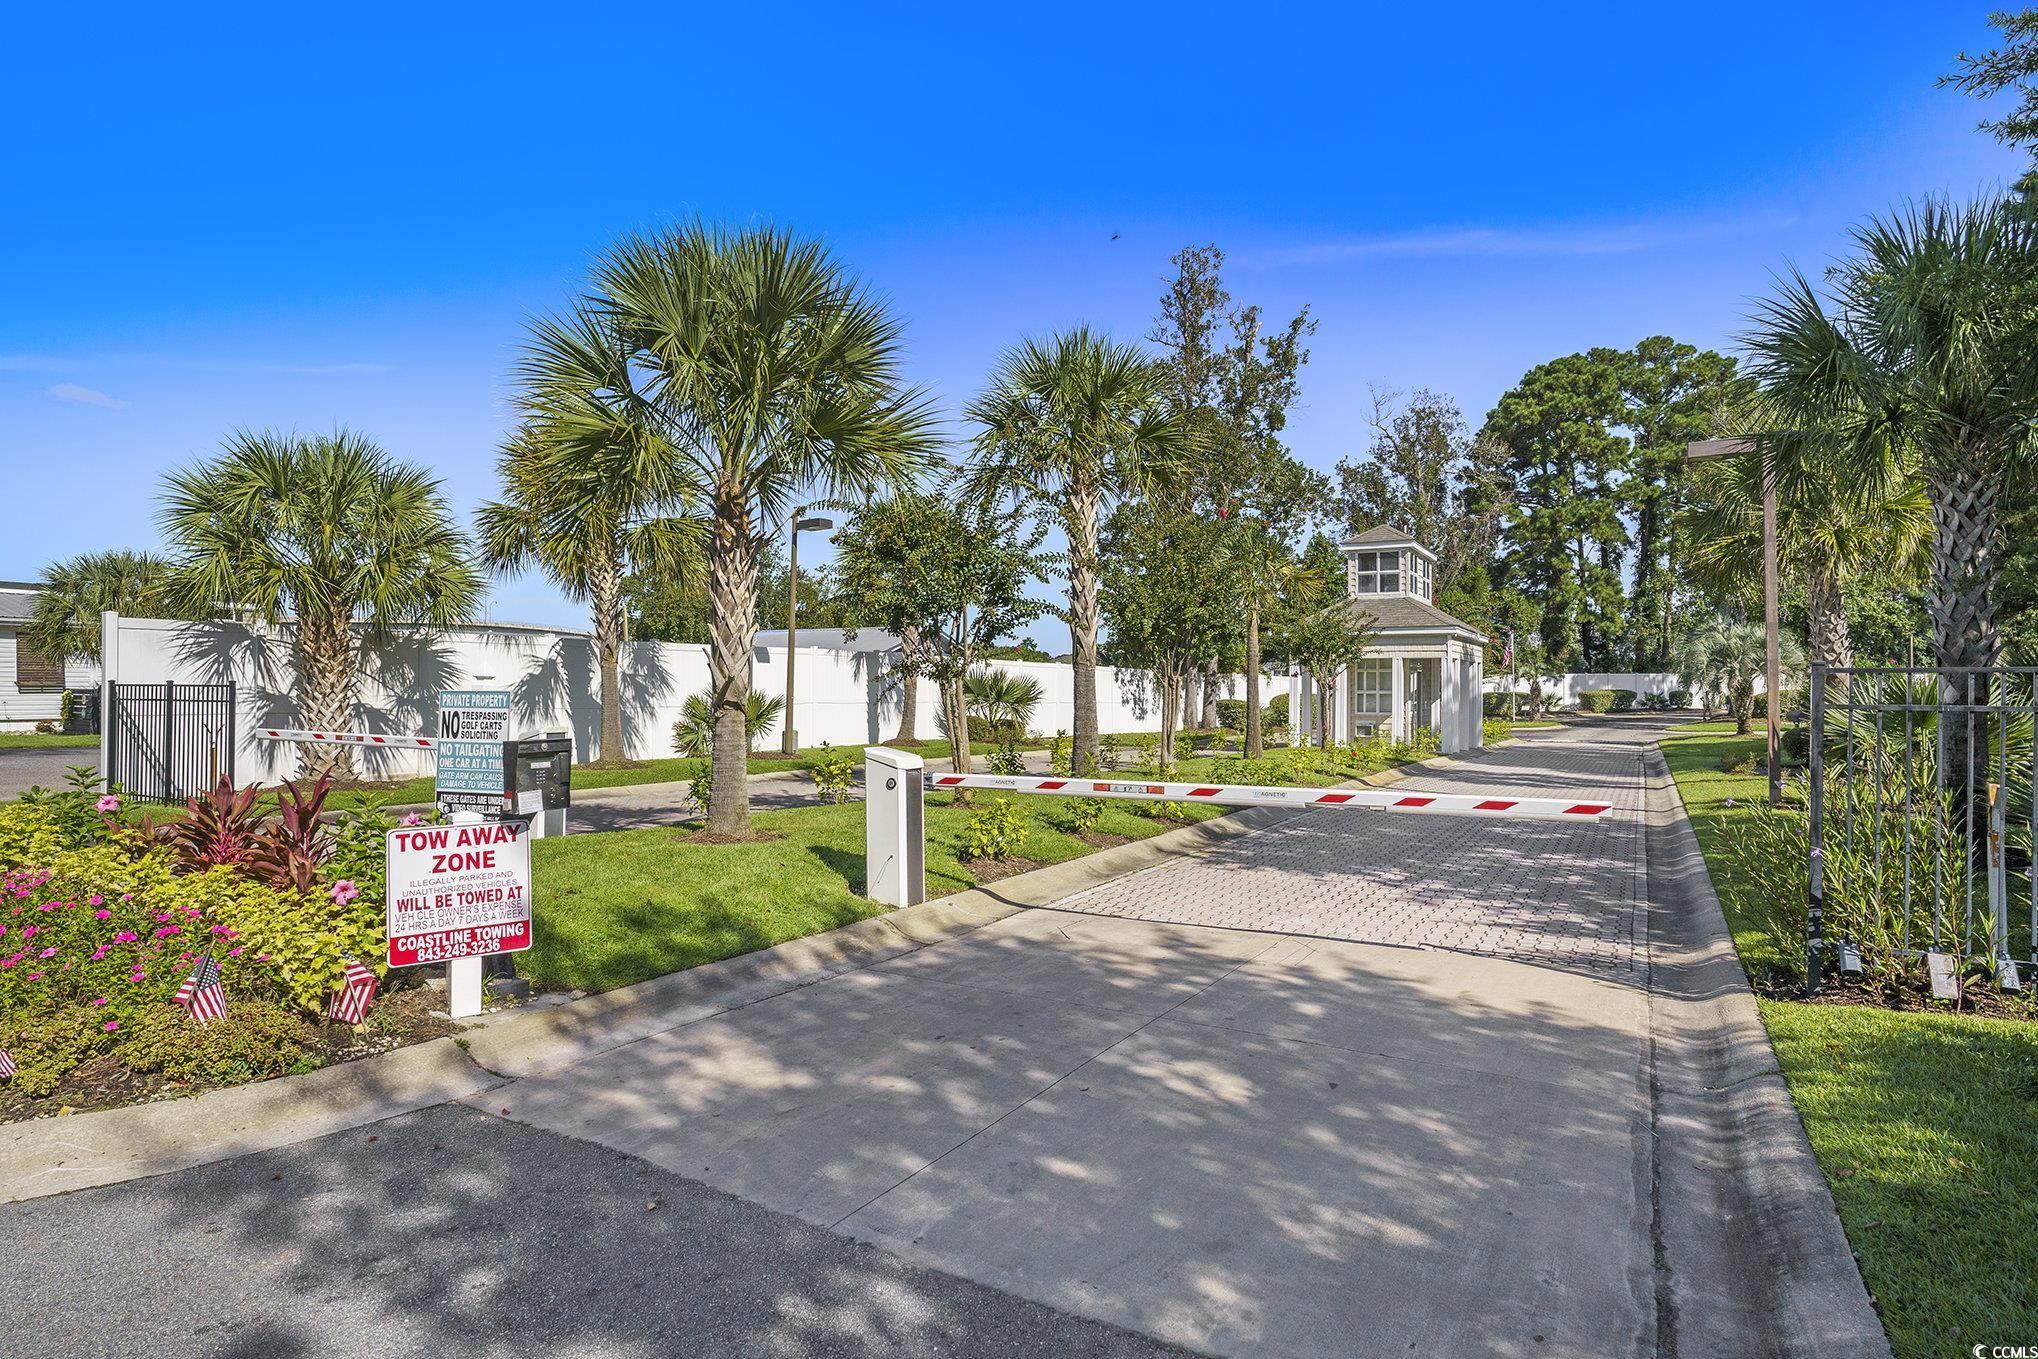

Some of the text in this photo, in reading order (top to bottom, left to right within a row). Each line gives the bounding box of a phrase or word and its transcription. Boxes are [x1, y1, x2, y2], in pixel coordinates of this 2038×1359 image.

[442, 695, 508, 708] PRIVATE PROPERTY
[462, 711, 507, 720] TRESPASSING
[441, 710, 460, 739] NO
[461, 721, 503, 730] GOLF CARTS
[461, 731, 498, 740] SOLICITING
[440, 743, 453, 756] NO
[439, 758, 504, 770] ONE CAR AT A TIM
[440, 780, 467, 788] DAMAGE
[468, 780, 476, 788] TO
[443, 794, 459, 803] THESE
[460, 794, 476, 804] GATES
[477, 795, 487, 804] ARE
[451, 804, 501, 814] VIDEO SURVEILLANCE
[396, 825, 520, 852] TOW AWAY
[432, 850, 495, 874] ZONE
[410, 870, 513, 887] ILLEGALLY PARKED AND
[402, 878, 517, 898] UNAUTHORIZED VEHICLES
[396, 886, 523, 912] WILL BE TOWED AT
[438, 905, 479, 918] OWNER'S
[482, 900, 522, 912] EXPENSE
[395, 908, 524, 933] 24 HRS A DAY 7 DAYS A WEEK
[397, 923, 524, 952] COASTLINE TOWING
[417, 940, 500, 962] 843-249-3236
